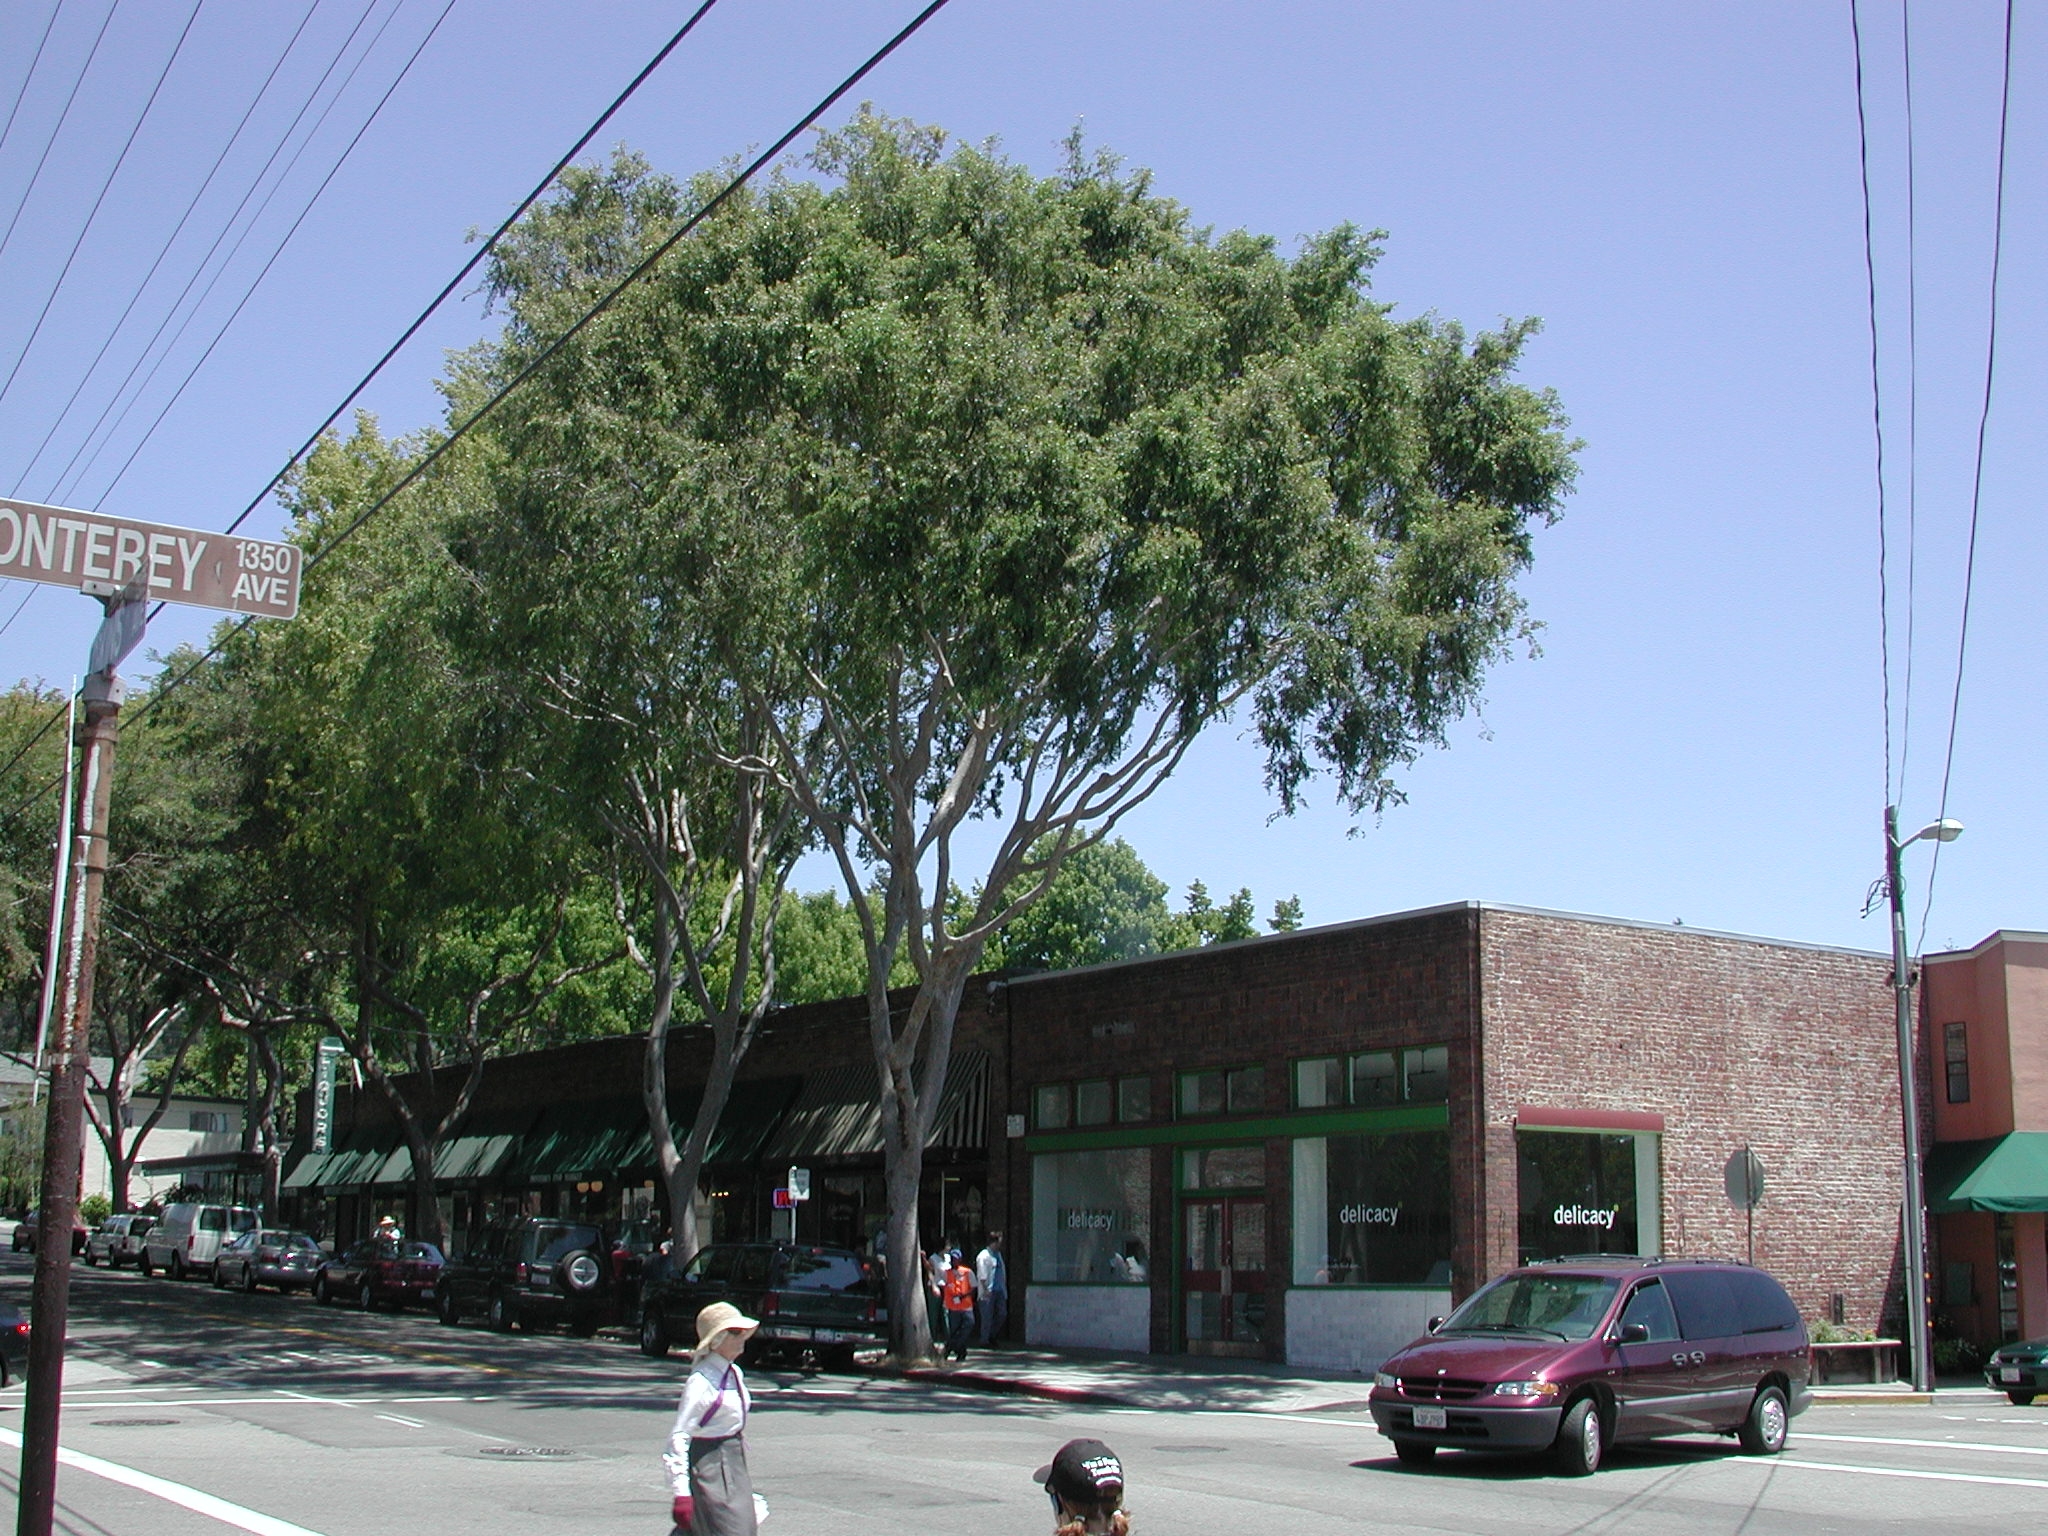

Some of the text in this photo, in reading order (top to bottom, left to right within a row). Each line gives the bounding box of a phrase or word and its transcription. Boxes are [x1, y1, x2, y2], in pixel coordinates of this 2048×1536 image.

[0, 508, 207, 592] ONTEREY
[236, 540, 291, 574] 1350
[231, 573, 289, 606] AVE
[1068, 1211, 1113, 1231] delicacy
[1340, 1203, 1398, 1226] delicacy
[1553, 1204, 1614, 1230] delicacy
